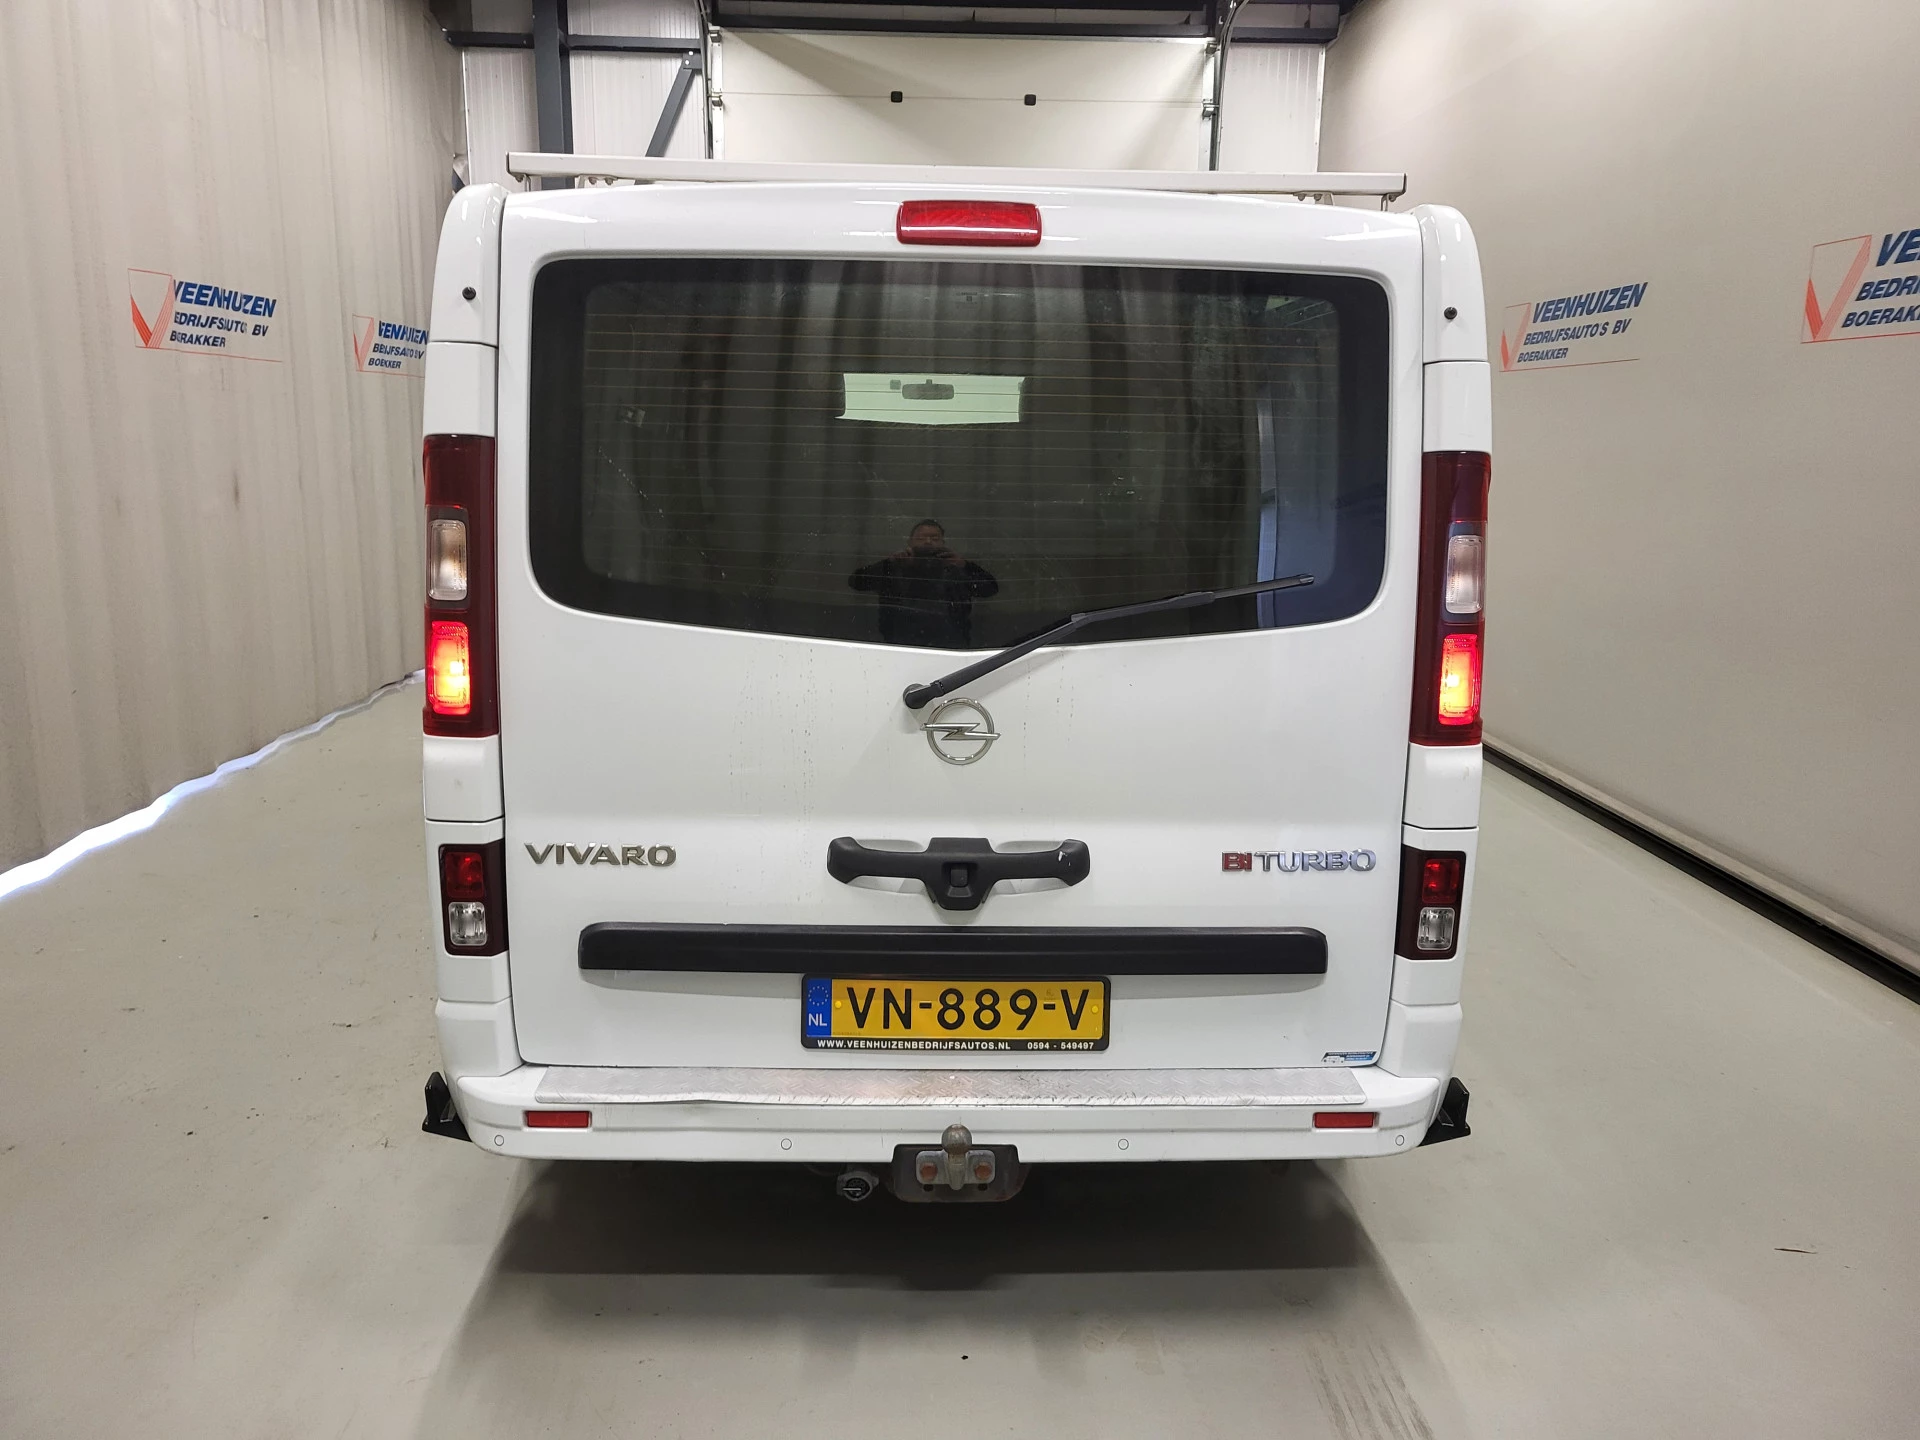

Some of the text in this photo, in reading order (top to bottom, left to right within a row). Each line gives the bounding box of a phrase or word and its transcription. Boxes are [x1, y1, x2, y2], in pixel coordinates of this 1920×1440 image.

[1532, 282, 1648, 324] VEENHUIZEN
[251, 323, 269, 337] BV
[1523, 318, 1632, 346] BEDRIJFSAUTO'S BV
[1517, 347, 1568, 363] BOERAKKER
[524, 842, 677, 867] VIVARO
[846, 986, 1090, 1031] VN-889-V
[808, 1013, 828, 1027] NL
[817, 1039, 1011, 1050] WWW.VEENHUIZENBEDRIJFSAUTOS.NL
[1027, 1041, 1050, 1050] 0594
[1060, 1041, 1094, 1050] 549497
